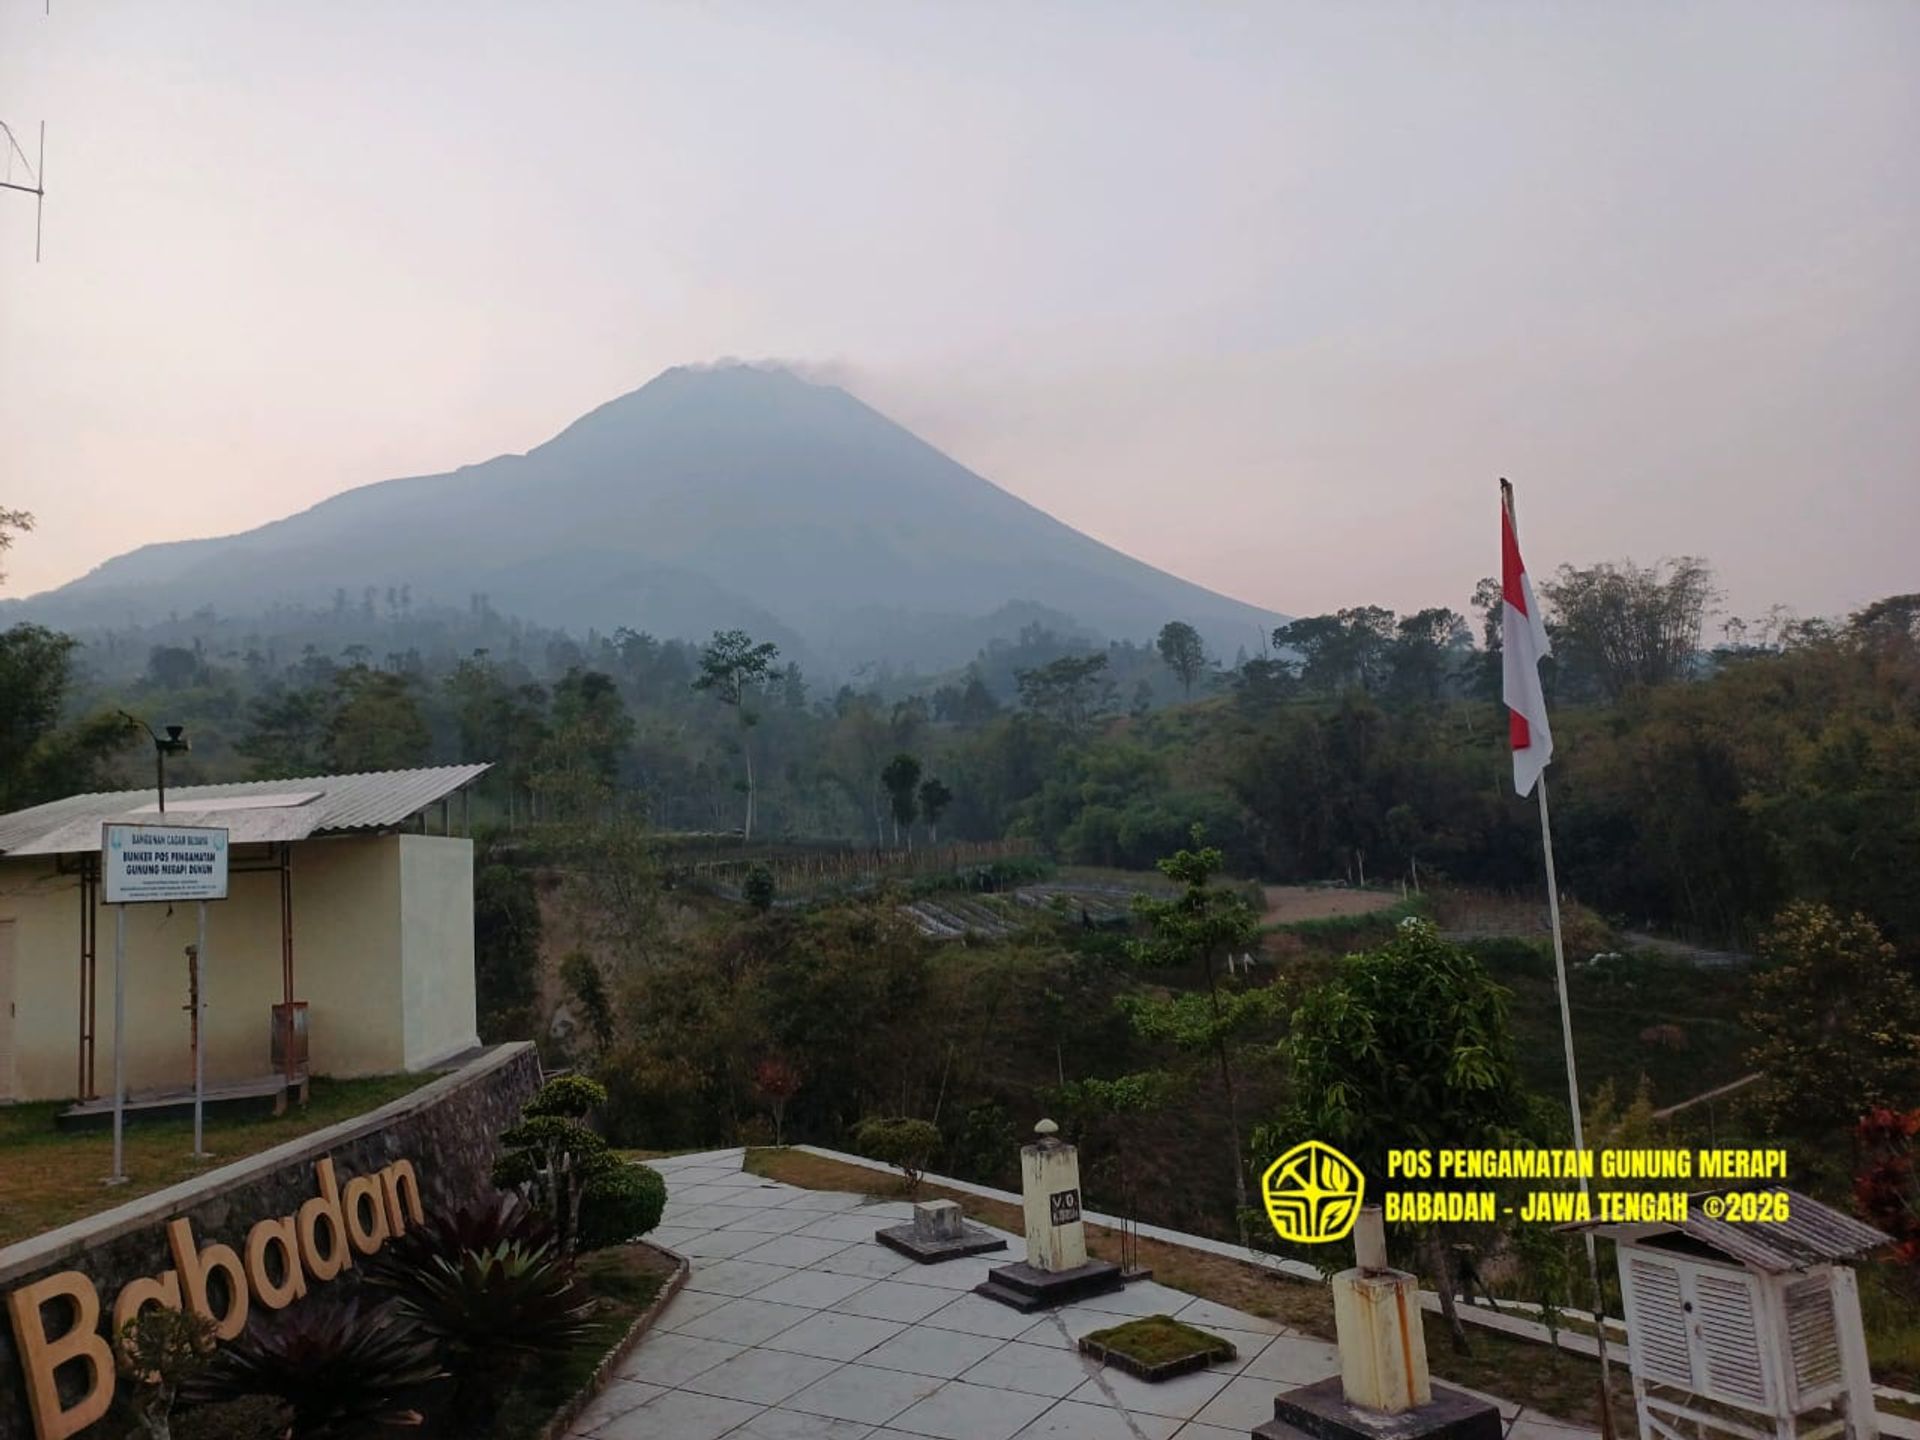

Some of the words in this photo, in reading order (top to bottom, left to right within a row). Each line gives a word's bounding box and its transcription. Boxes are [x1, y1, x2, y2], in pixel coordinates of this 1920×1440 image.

[123, 851, 153, 862] BUNKER
[154, 851, 169, 862] POS
[126, 864, 160, 875] GUNUNG
[161, 864, 187, 875] MERAPI
[10, 1153, 425, 1440] Babadan
